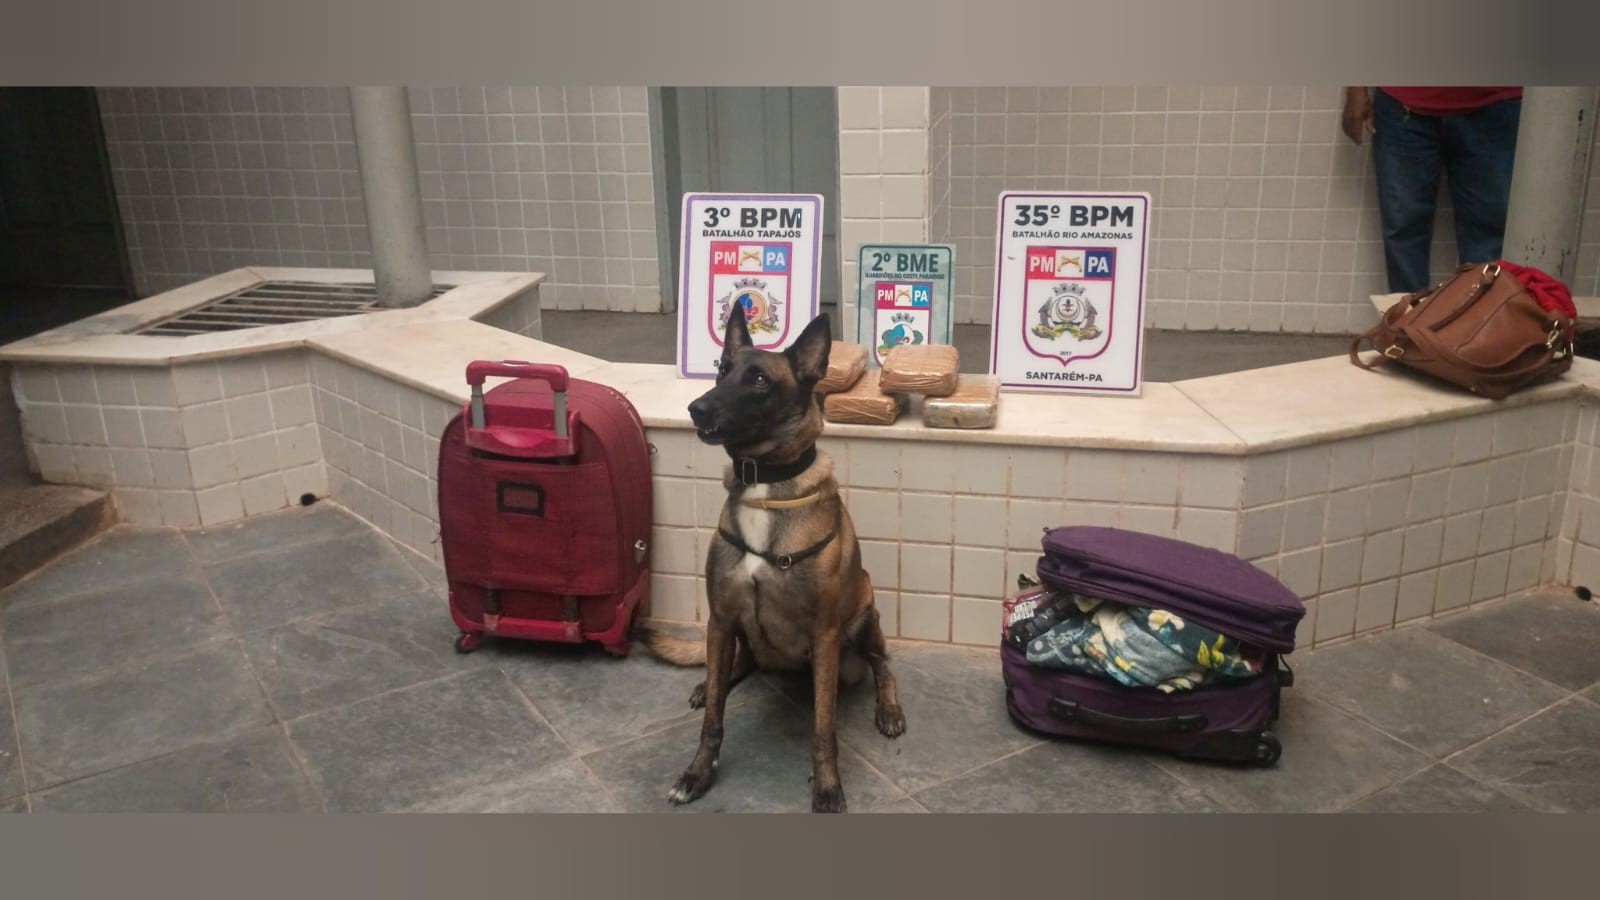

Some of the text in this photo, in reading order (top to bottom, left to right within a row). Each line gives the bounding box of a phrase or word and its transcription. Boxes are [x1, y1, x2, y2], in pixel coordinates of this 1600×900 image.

[740, 207, 803, 229] BPM
[1014, 204, 1135, 228] 35º BPM
[702, 228, 801, 238] BATALHÃO TAPAJÓS
[1012, 230, 1133, 240] BATALHÃO RIO AMAZONAS
[714, 251, 737, 265] PM
[766, 252, 786, 266] PA
[896, 253, 939, 273] BME
[1029, 256, 1054, 273] PM
[1087, 256, 1109, 273] PA
[877, 289, 894, 301] PM
[914, 290, 928, 302] PA
[1026, 370, 1103, 383] SANTARÉM-PA
